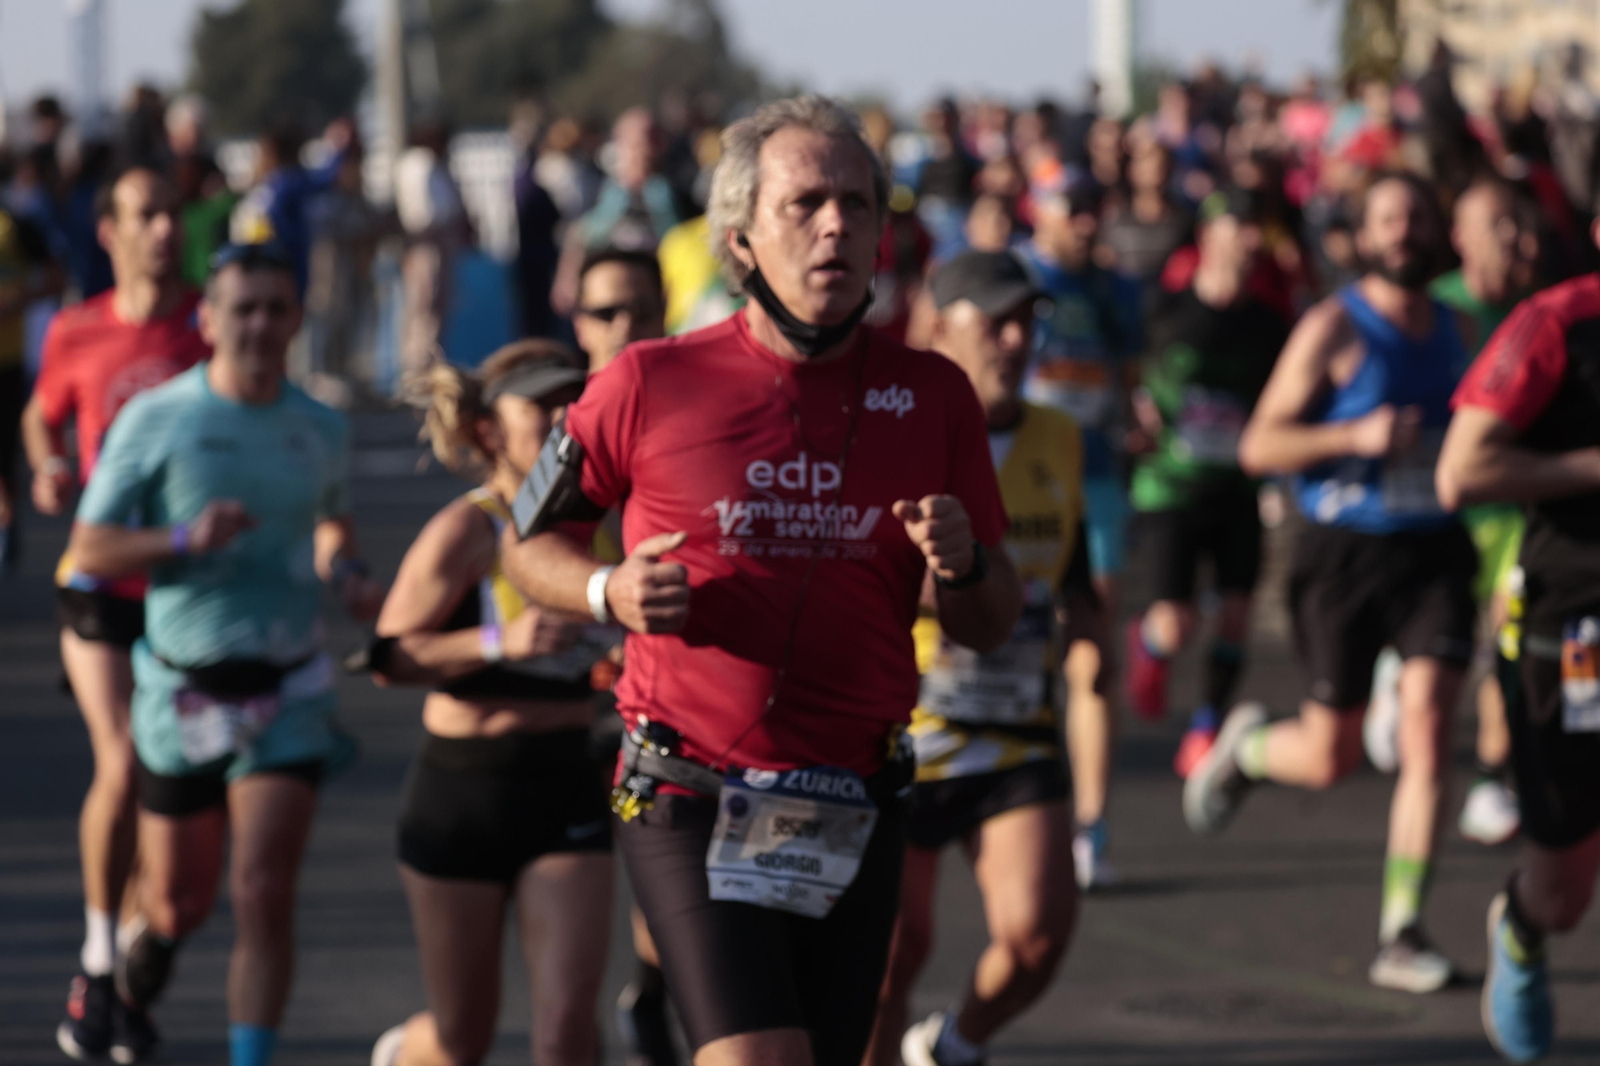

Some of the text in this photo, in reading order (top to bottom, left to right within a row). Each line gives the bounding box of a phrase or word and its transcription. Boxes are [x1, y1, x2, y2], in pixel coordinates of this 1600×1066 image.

[864, 384, 915, 418] edp
[746, 452, 841, 497] edp
[749, 500, 858, 522] maratón
[774, 518, 857, 540] sevilla
[782, 769, 866, 800] ZURICH
